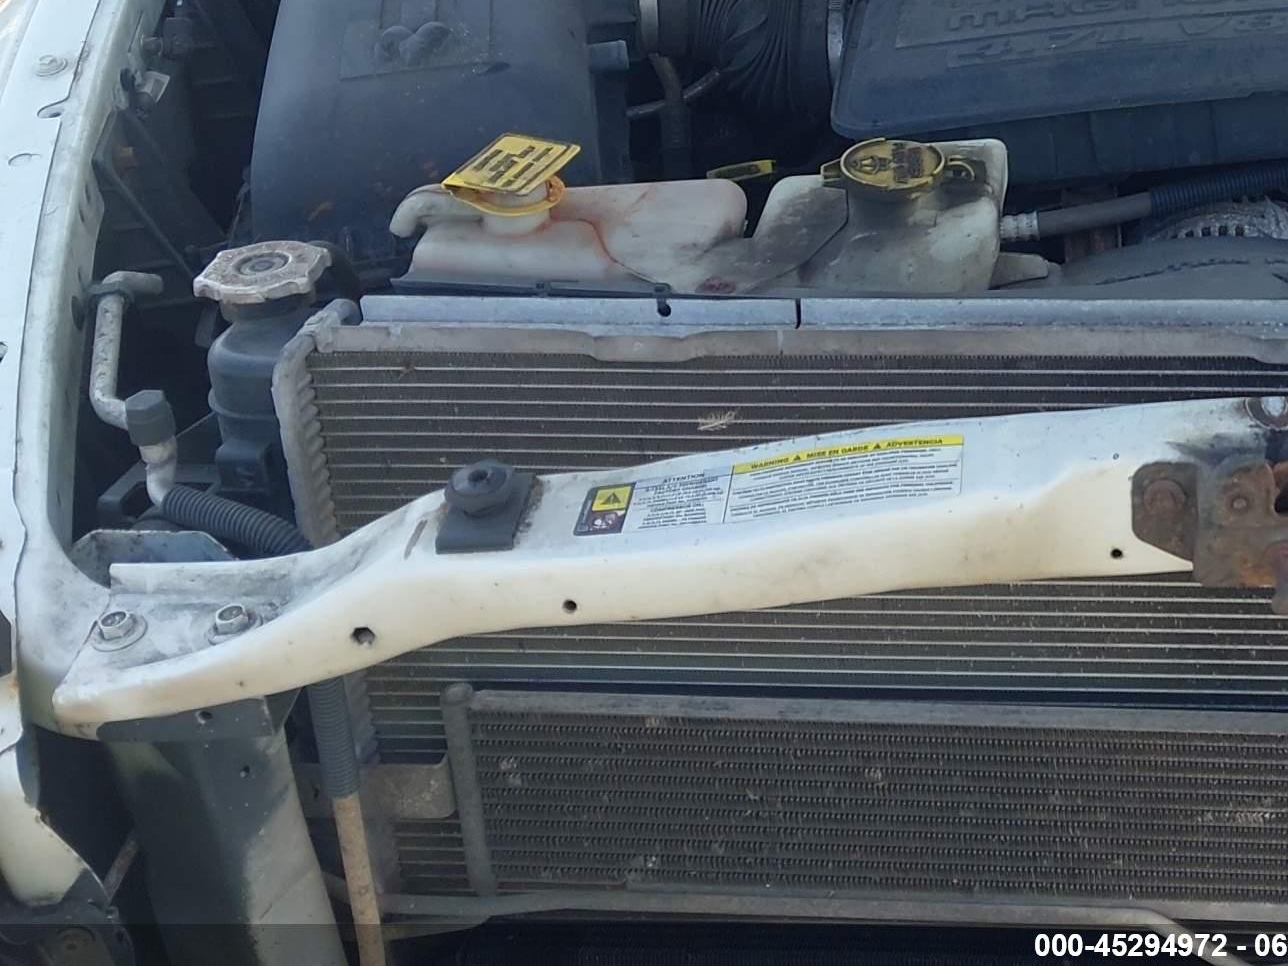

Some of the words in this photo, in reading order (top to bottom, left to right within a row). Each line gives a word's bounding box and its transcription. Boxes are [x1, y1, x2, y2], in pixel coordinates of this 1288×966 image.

[750, 457, 790, 470] WARNING
[806, 450, 827, 459] MISE
[828, 447, 840, 456] EN
[841, 444, 869, 454] GARDE
[886, 437, 944, 449] ADVERTENCIA
